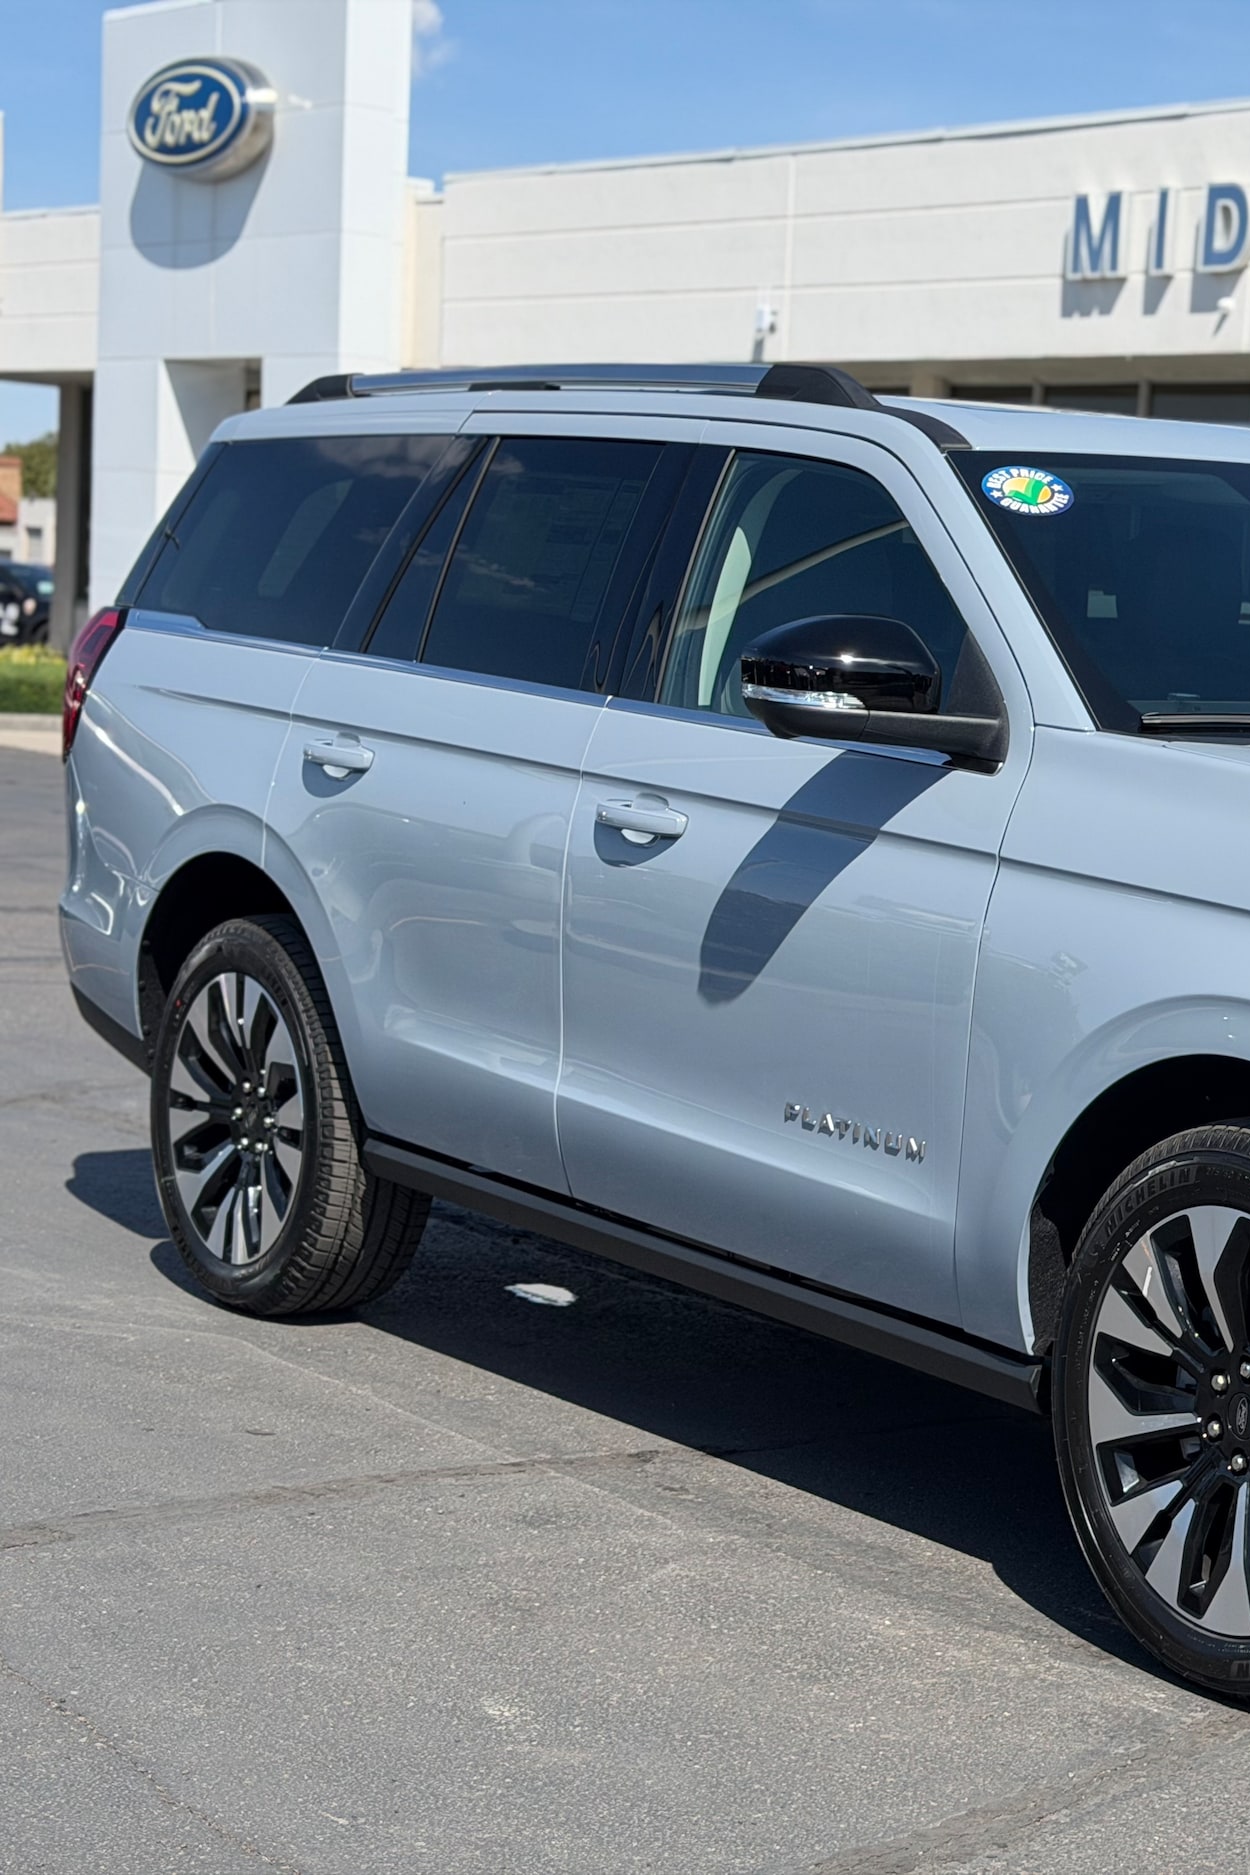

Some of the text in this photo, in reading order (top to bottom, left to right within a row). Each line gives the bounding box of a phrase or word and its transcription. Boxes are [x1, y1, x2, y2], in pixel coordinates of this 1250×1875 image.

[144, 79, 220, 149] Ford
[784, 1102, 926, 1164] PLATINUM
[1104, 1167, 1193, 1237] MICHELIN
